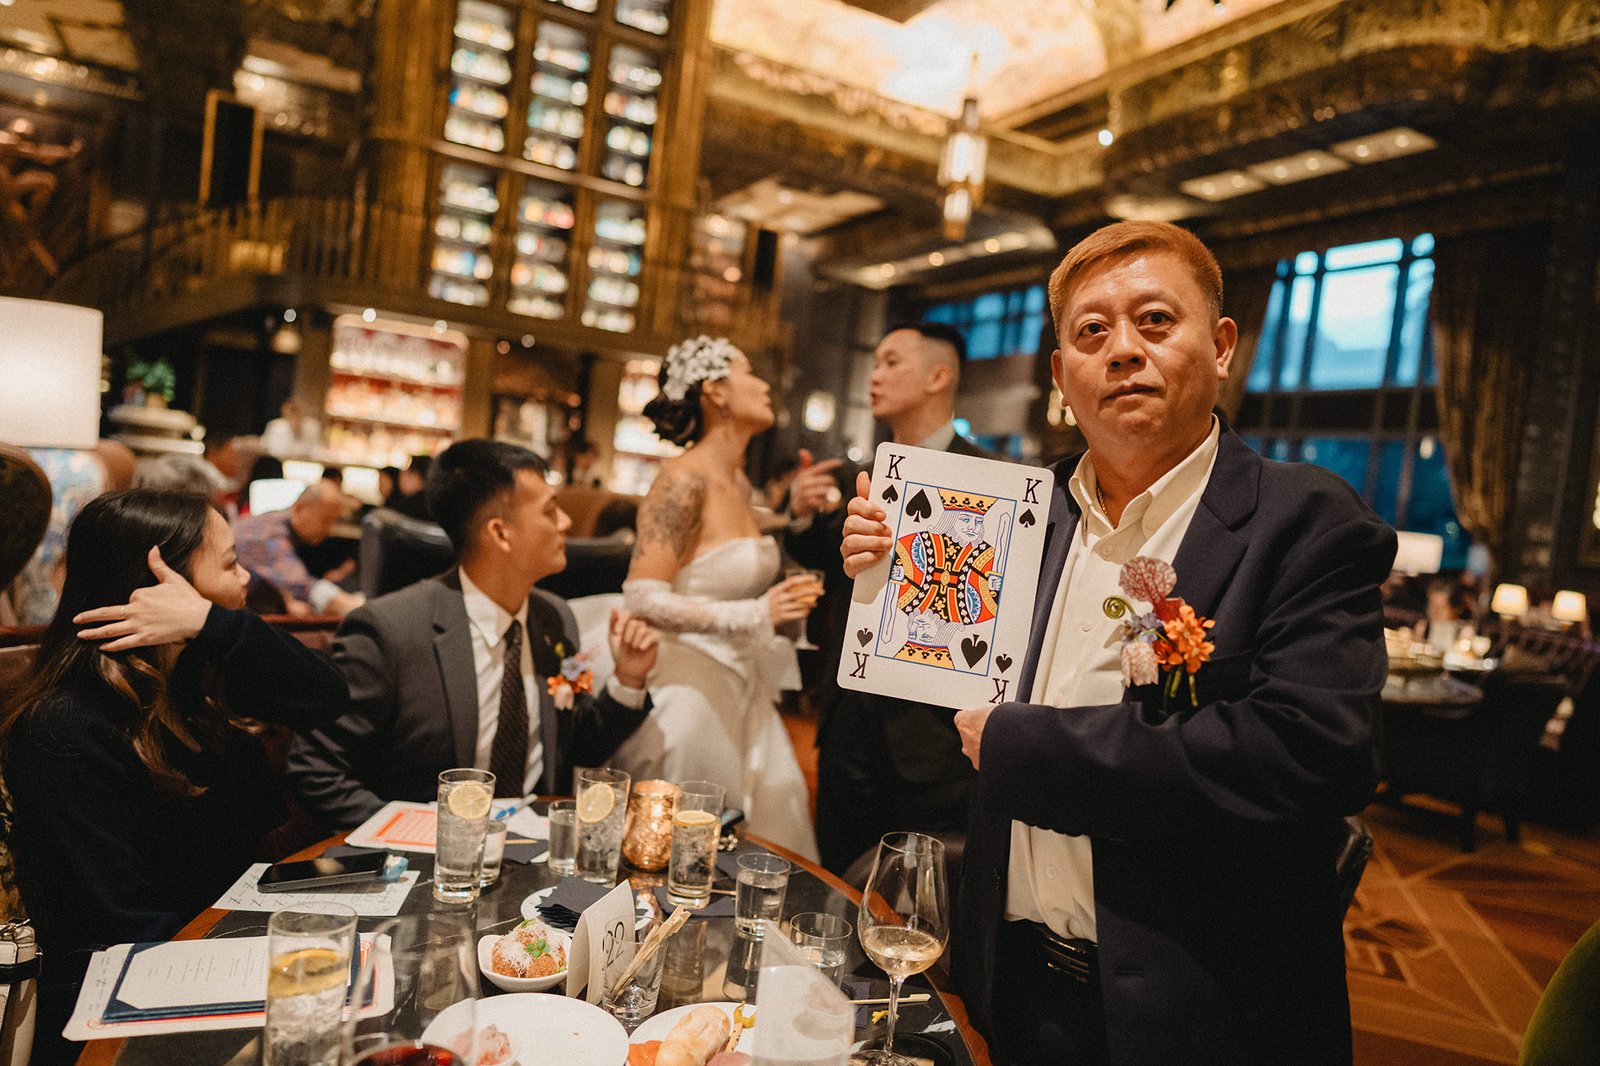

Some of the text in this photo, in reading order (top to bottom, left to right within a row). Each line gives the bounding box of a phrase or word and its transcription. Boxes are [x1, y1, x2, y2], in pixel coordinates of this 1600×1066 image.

[886, 454, 906, 480] K
[1023, 478, 1043, 504] K
[850, 652, 870, 678] K
[989, 678, 1009, 704] K
